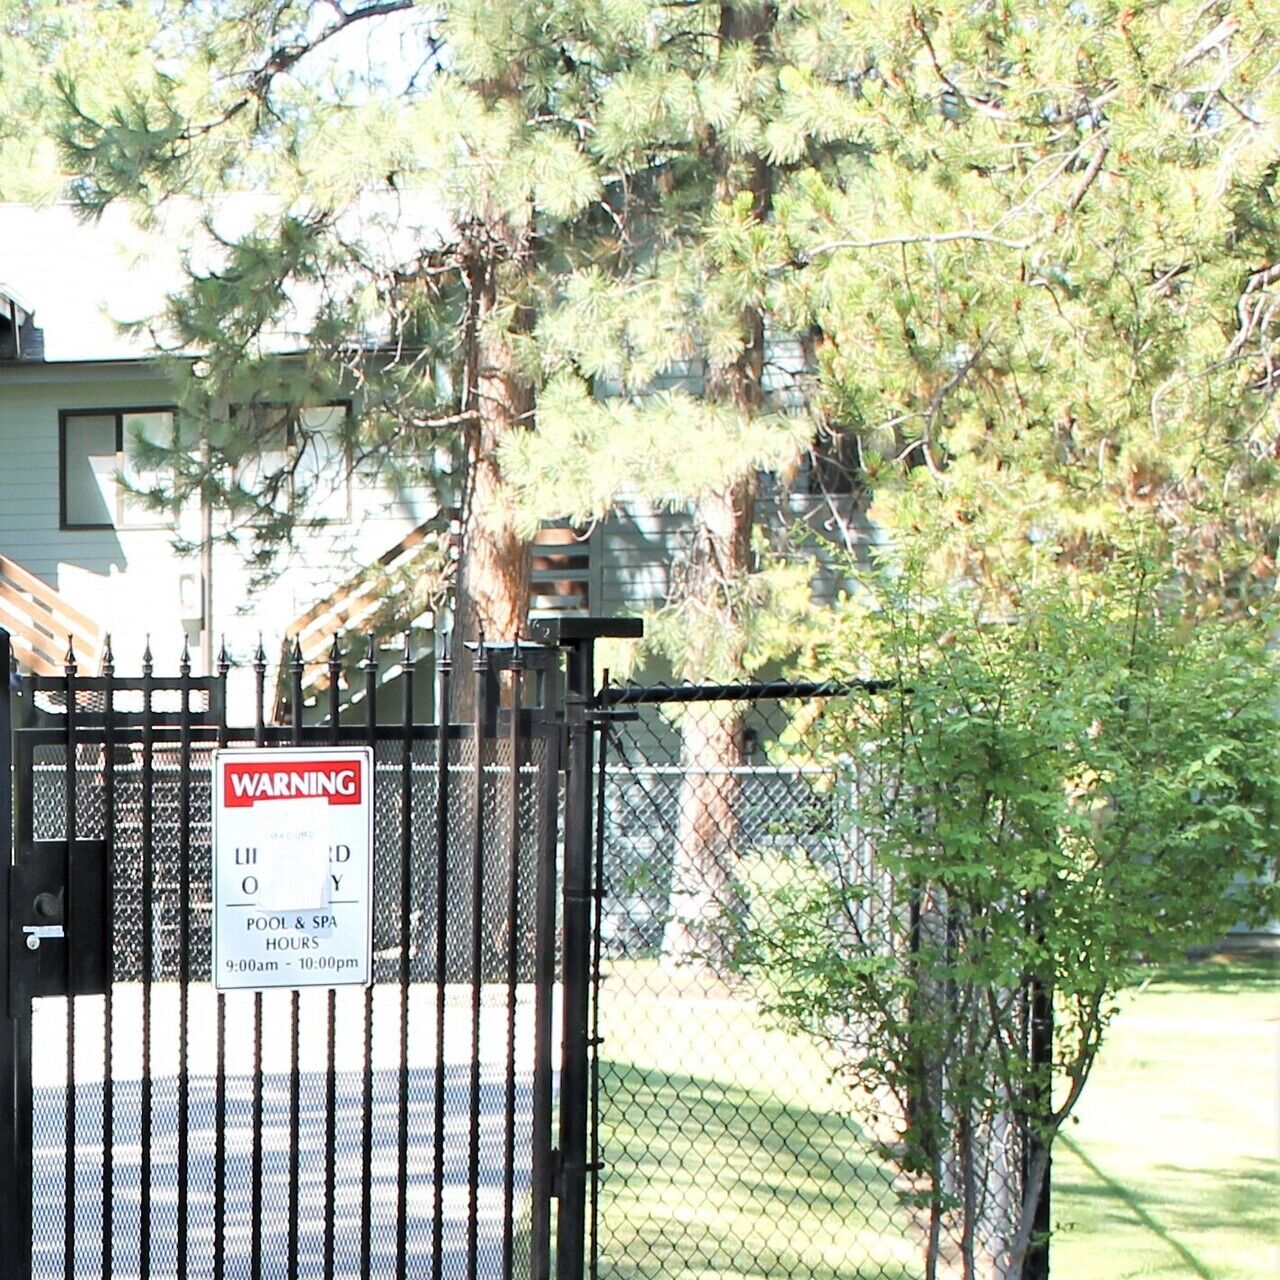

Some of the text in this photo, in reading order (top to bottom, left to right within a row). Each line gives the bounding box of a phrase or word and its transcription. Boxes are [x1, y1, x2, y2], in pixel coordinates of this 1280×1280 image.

[230, 770, 355, 797] WARNING
[247, 915, 338, 931] POOL & SPA
[266, 936, 320, 951] HOURS
[225, 959, 279, 972] 9:00am
[299, 956, 359, 973] 10:00pm
